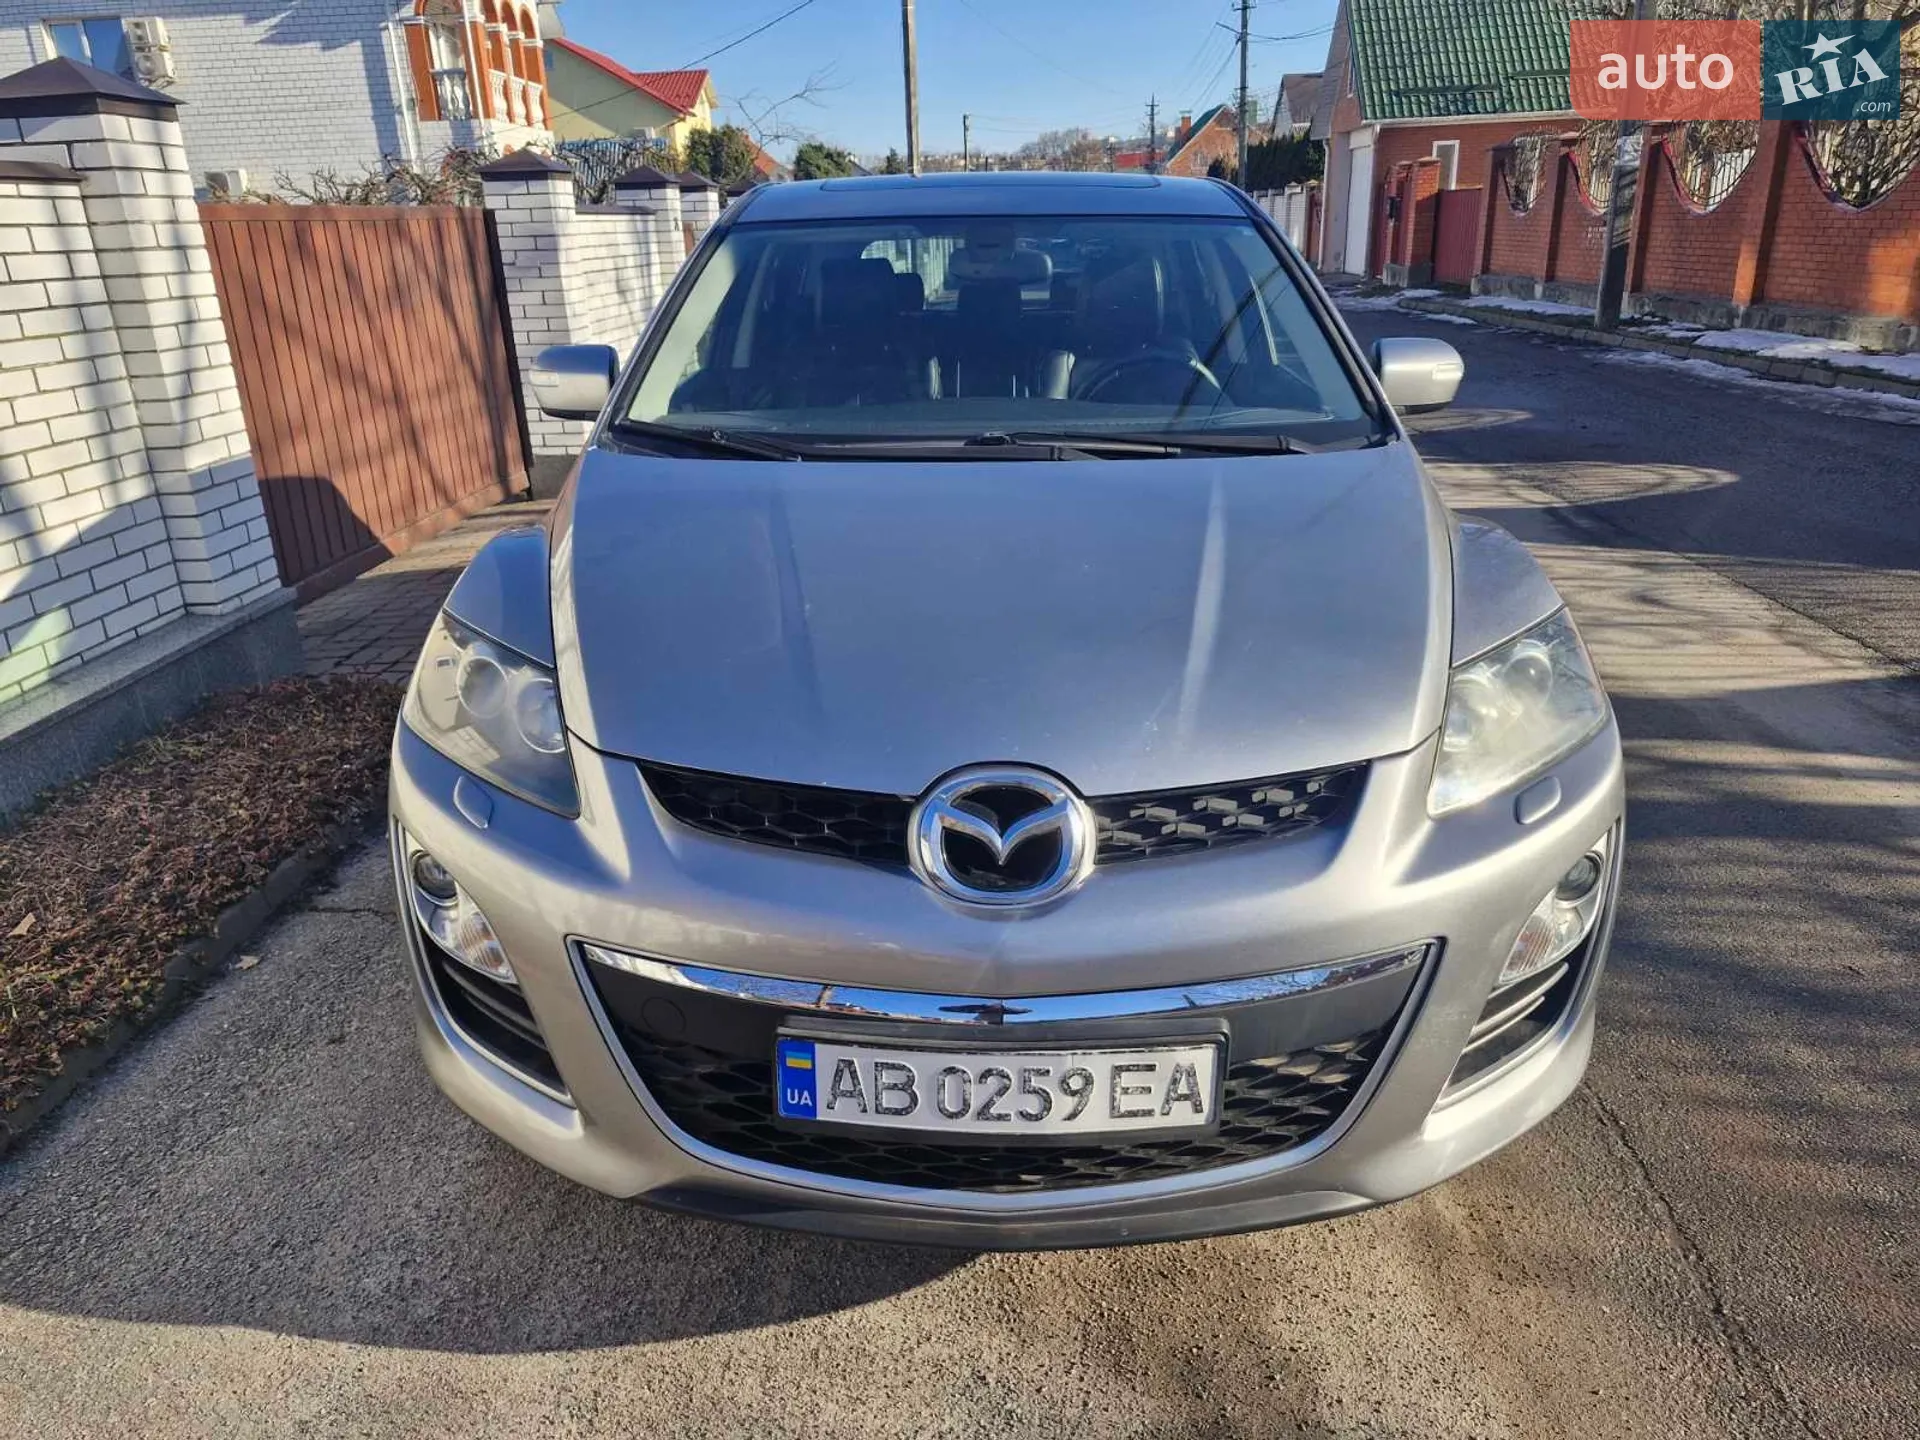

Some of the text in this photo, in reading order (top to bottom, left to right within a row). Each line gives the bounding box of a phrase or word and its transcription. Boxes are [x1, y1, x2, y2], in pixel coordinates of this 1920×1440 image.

[787, 1088, 813, 1107] UA
[826, 1058, 1204, 1122] AB 0259 EA
